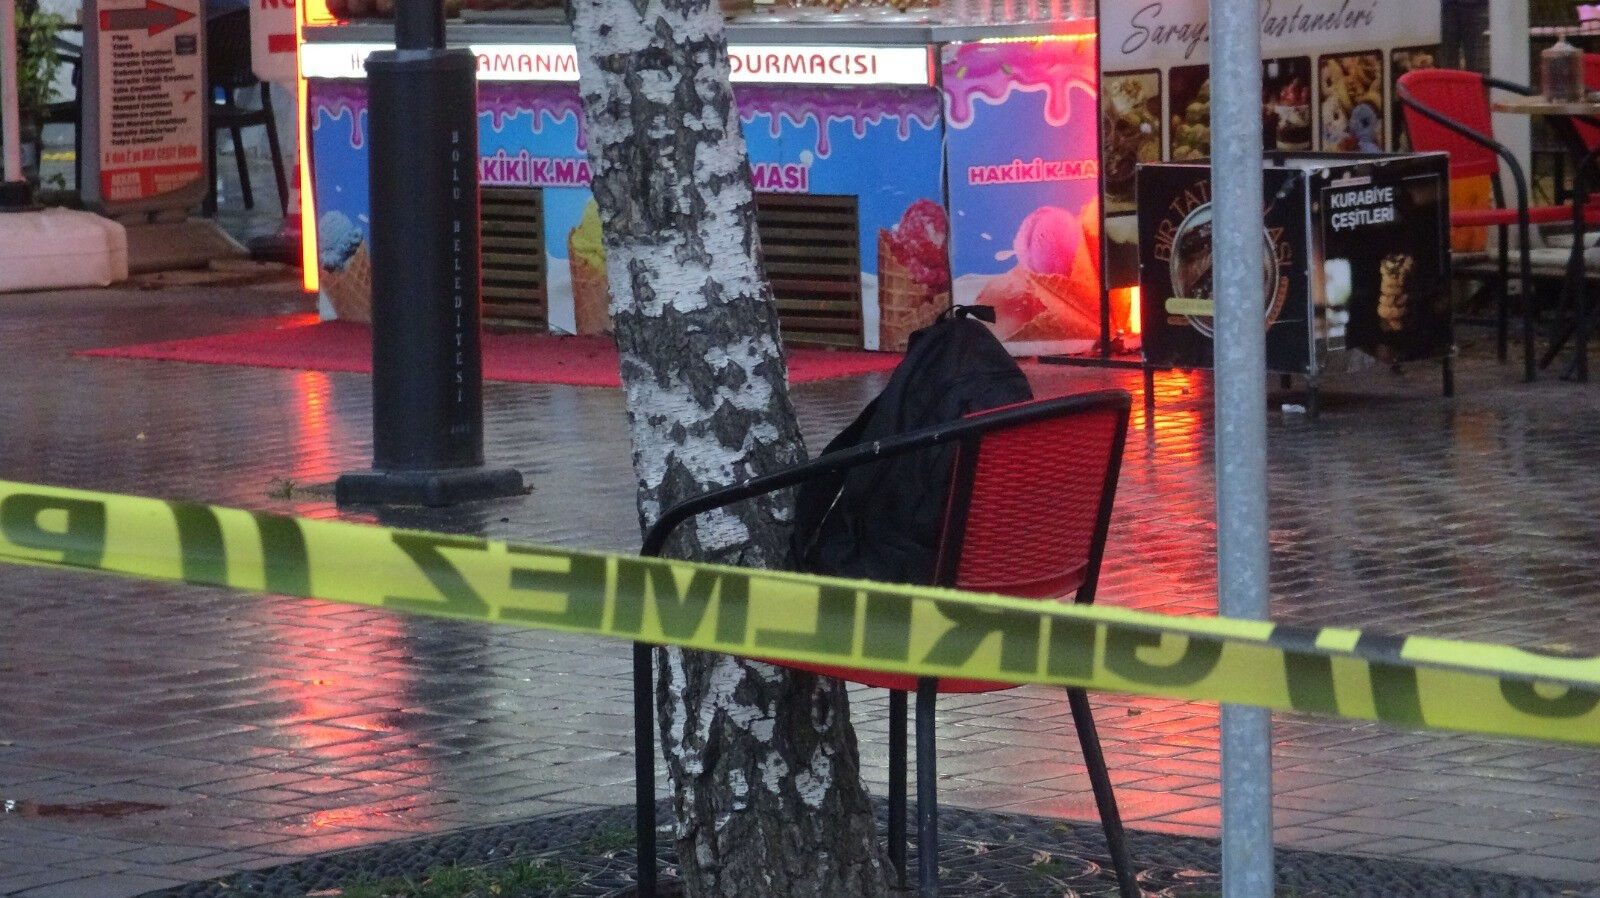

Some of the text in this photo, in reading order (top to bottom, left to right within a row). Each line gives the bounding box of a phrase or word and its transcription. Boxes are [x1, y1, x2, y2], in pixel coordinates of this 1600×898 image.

[1262, 0, 1377, 37] astaneleri
[969, 160, 1042, 183] HAKİKİ
[1331, 186, 1394, 208] KURABİYE
[1331, 204, 1395, 232] ÇEŞİTLERİ
